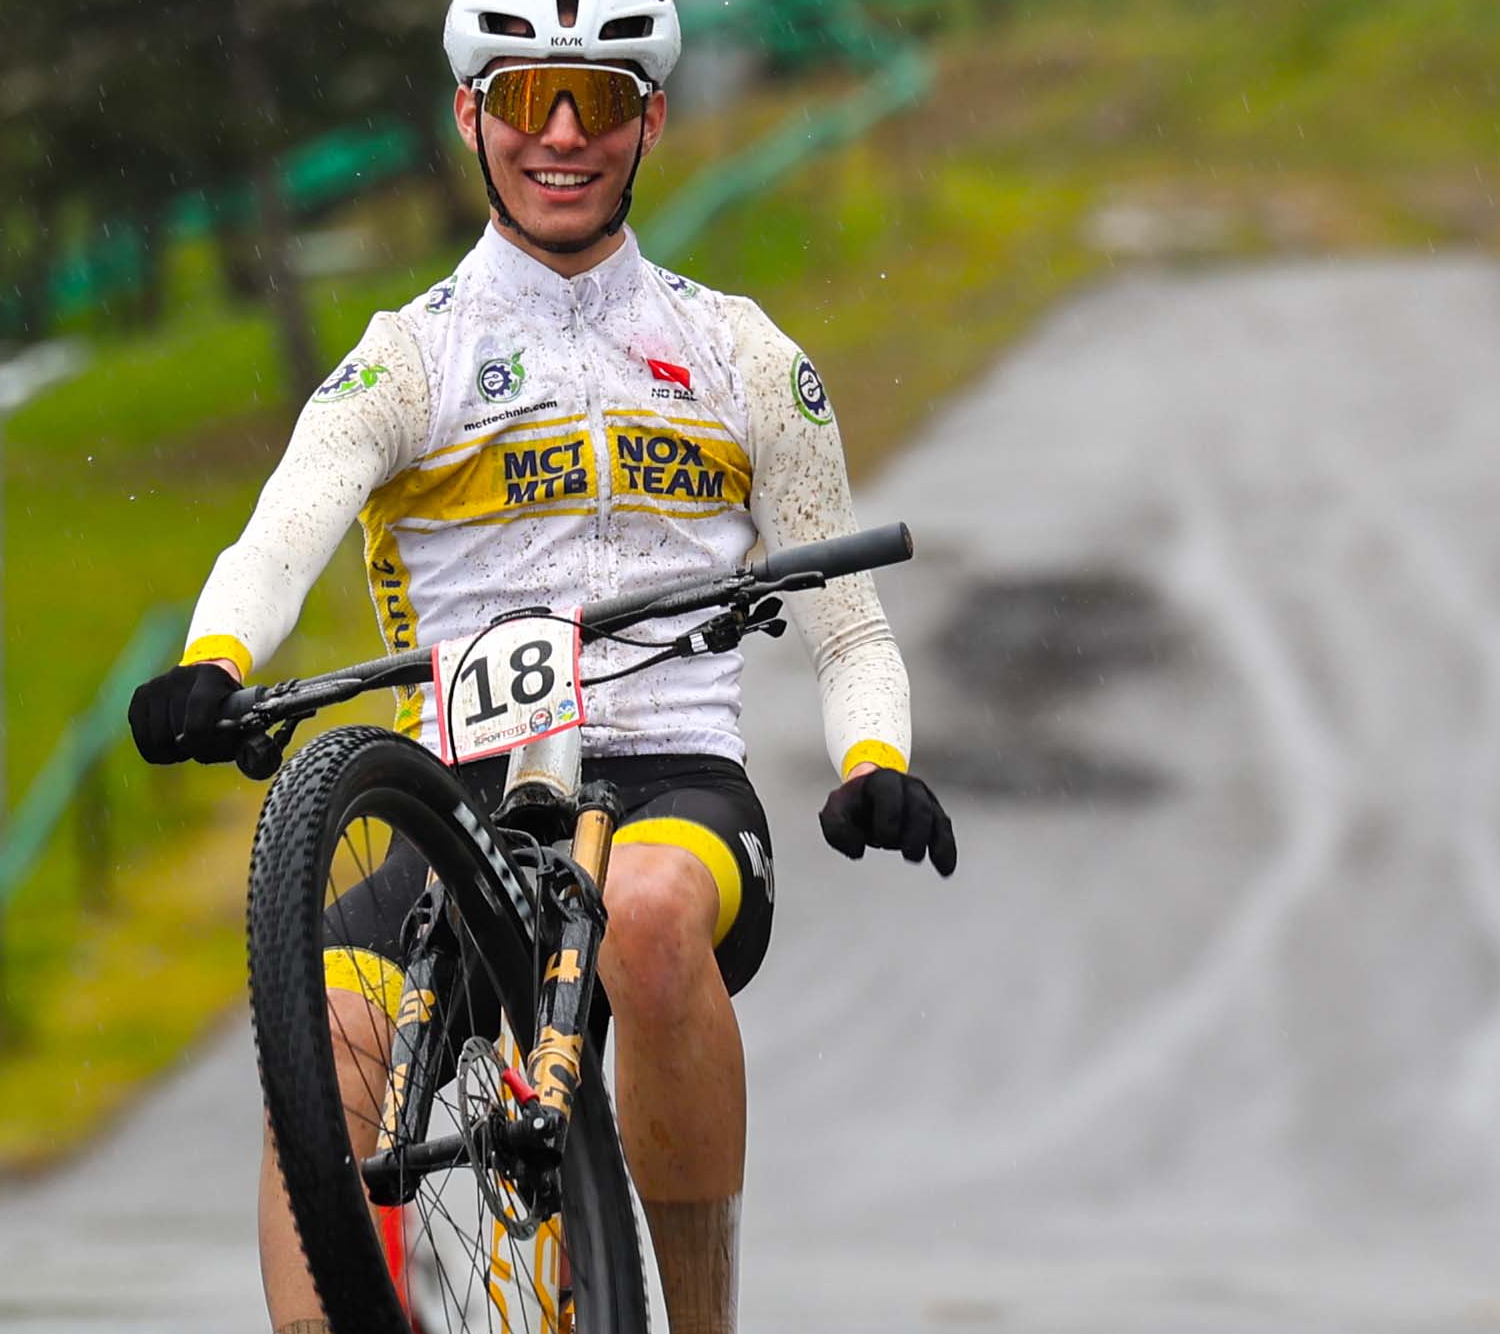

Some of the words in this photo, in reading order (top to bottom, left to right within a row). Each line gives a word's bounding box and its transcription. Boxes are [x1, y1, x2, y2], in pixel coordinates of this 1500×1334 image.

[464, 399, 558, 432] mcttechnic.com
[504, 439, 585, 479] MCT
[617, 435, 704, 466] NOX
[504, 469, 587, 505] MTB
[620, 463, 725, 497] TEAM
[460, 640, 555, 727] 18
